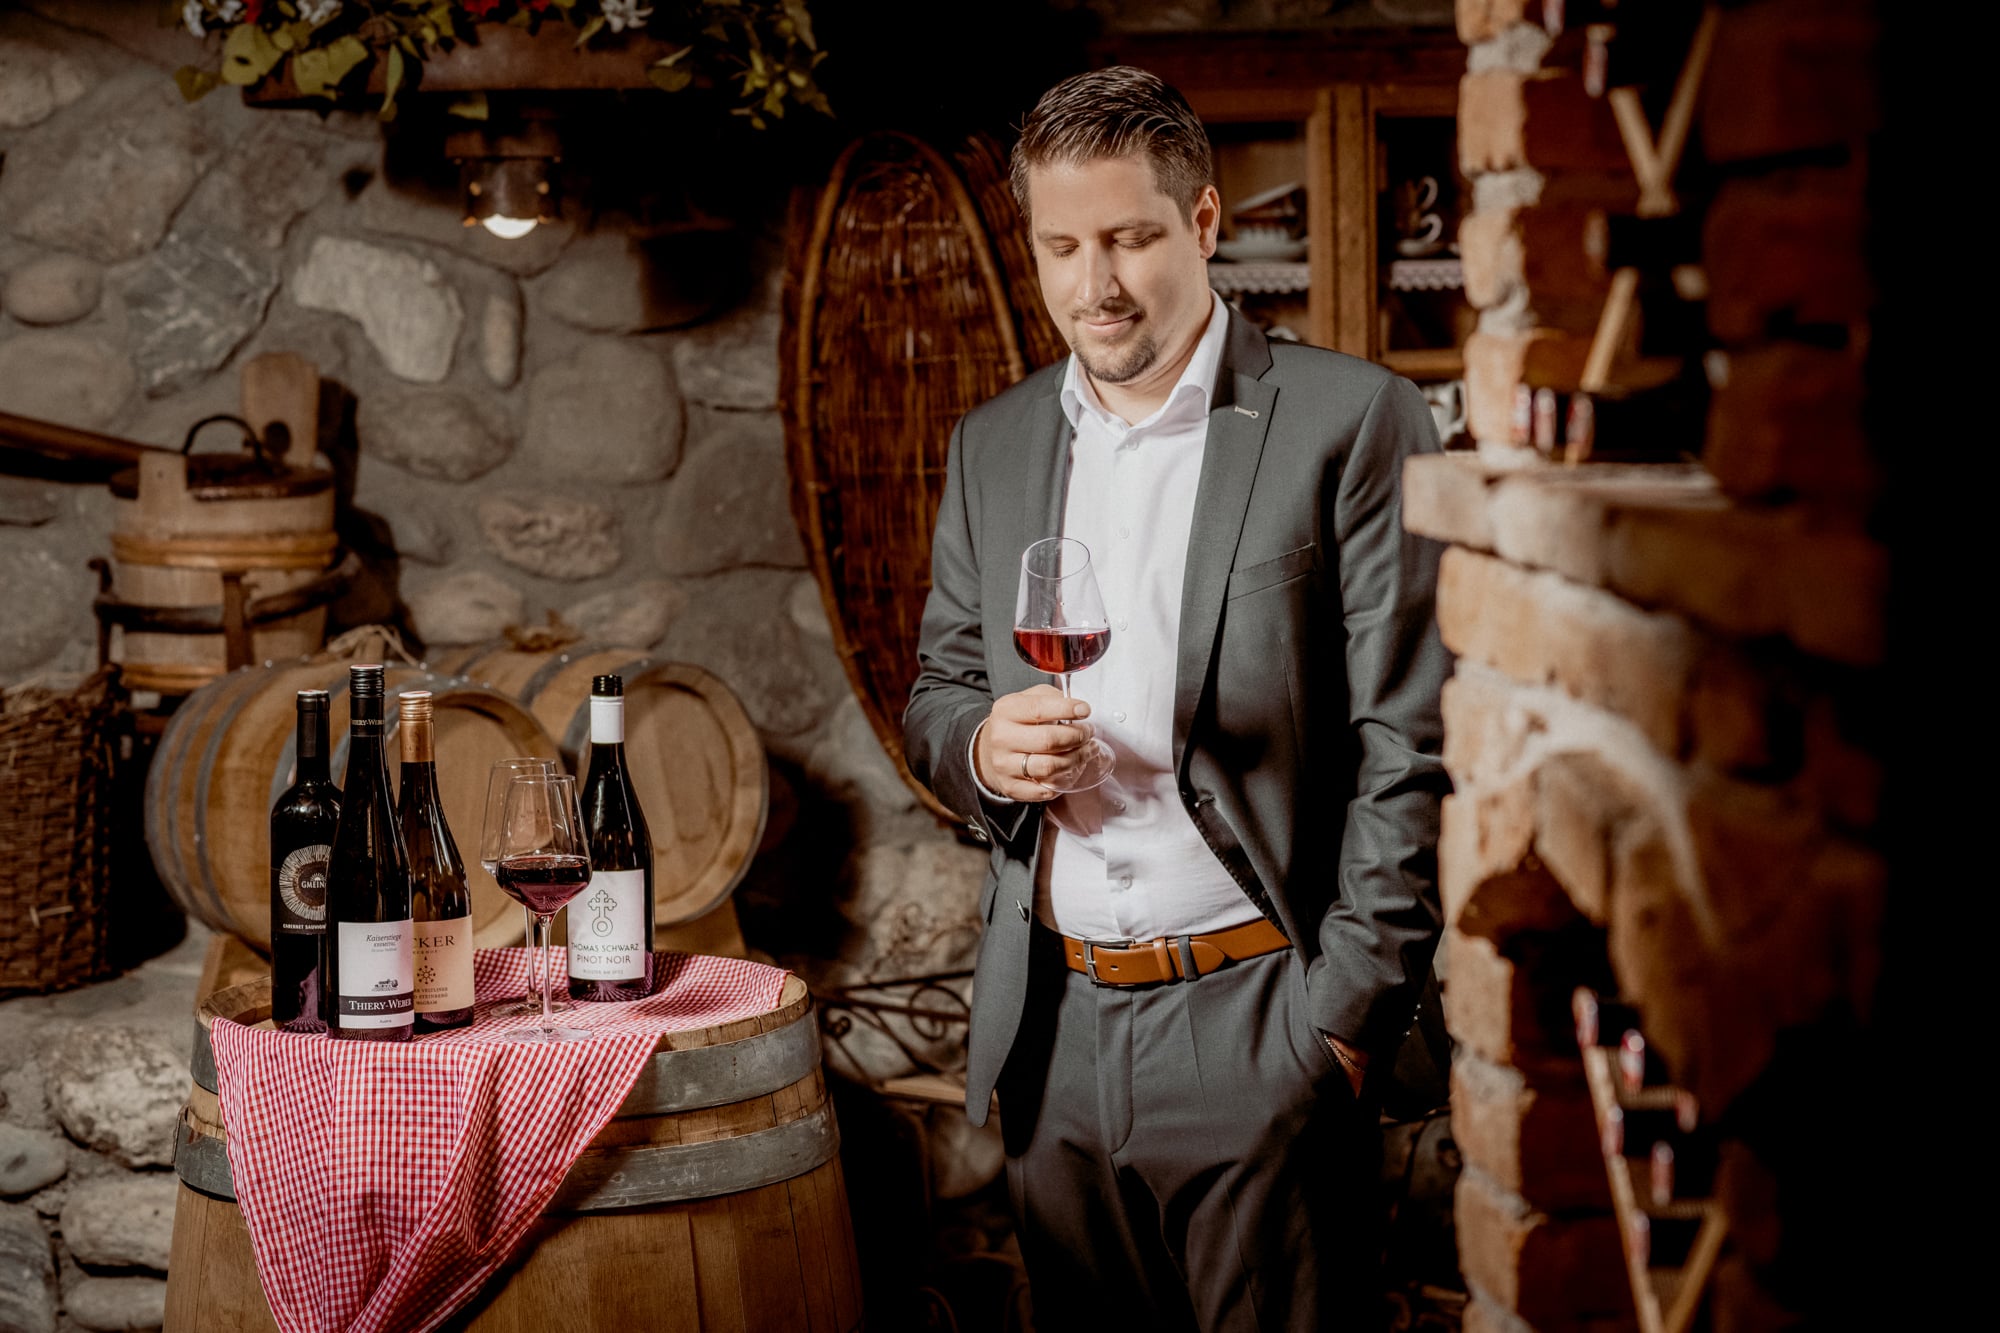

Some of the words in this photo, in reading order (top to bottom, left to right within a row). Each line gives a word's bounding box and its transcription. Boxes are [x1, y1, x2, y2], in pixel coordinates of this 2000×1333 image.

[413, 935, 455, 948] KER
[571, 942, 599, 952] THOMAS
[601, 943, 639, 952] SCHWARZ
[576, 954, 602, 964] PINOT
[606, 954, 631, 964] NOIR
